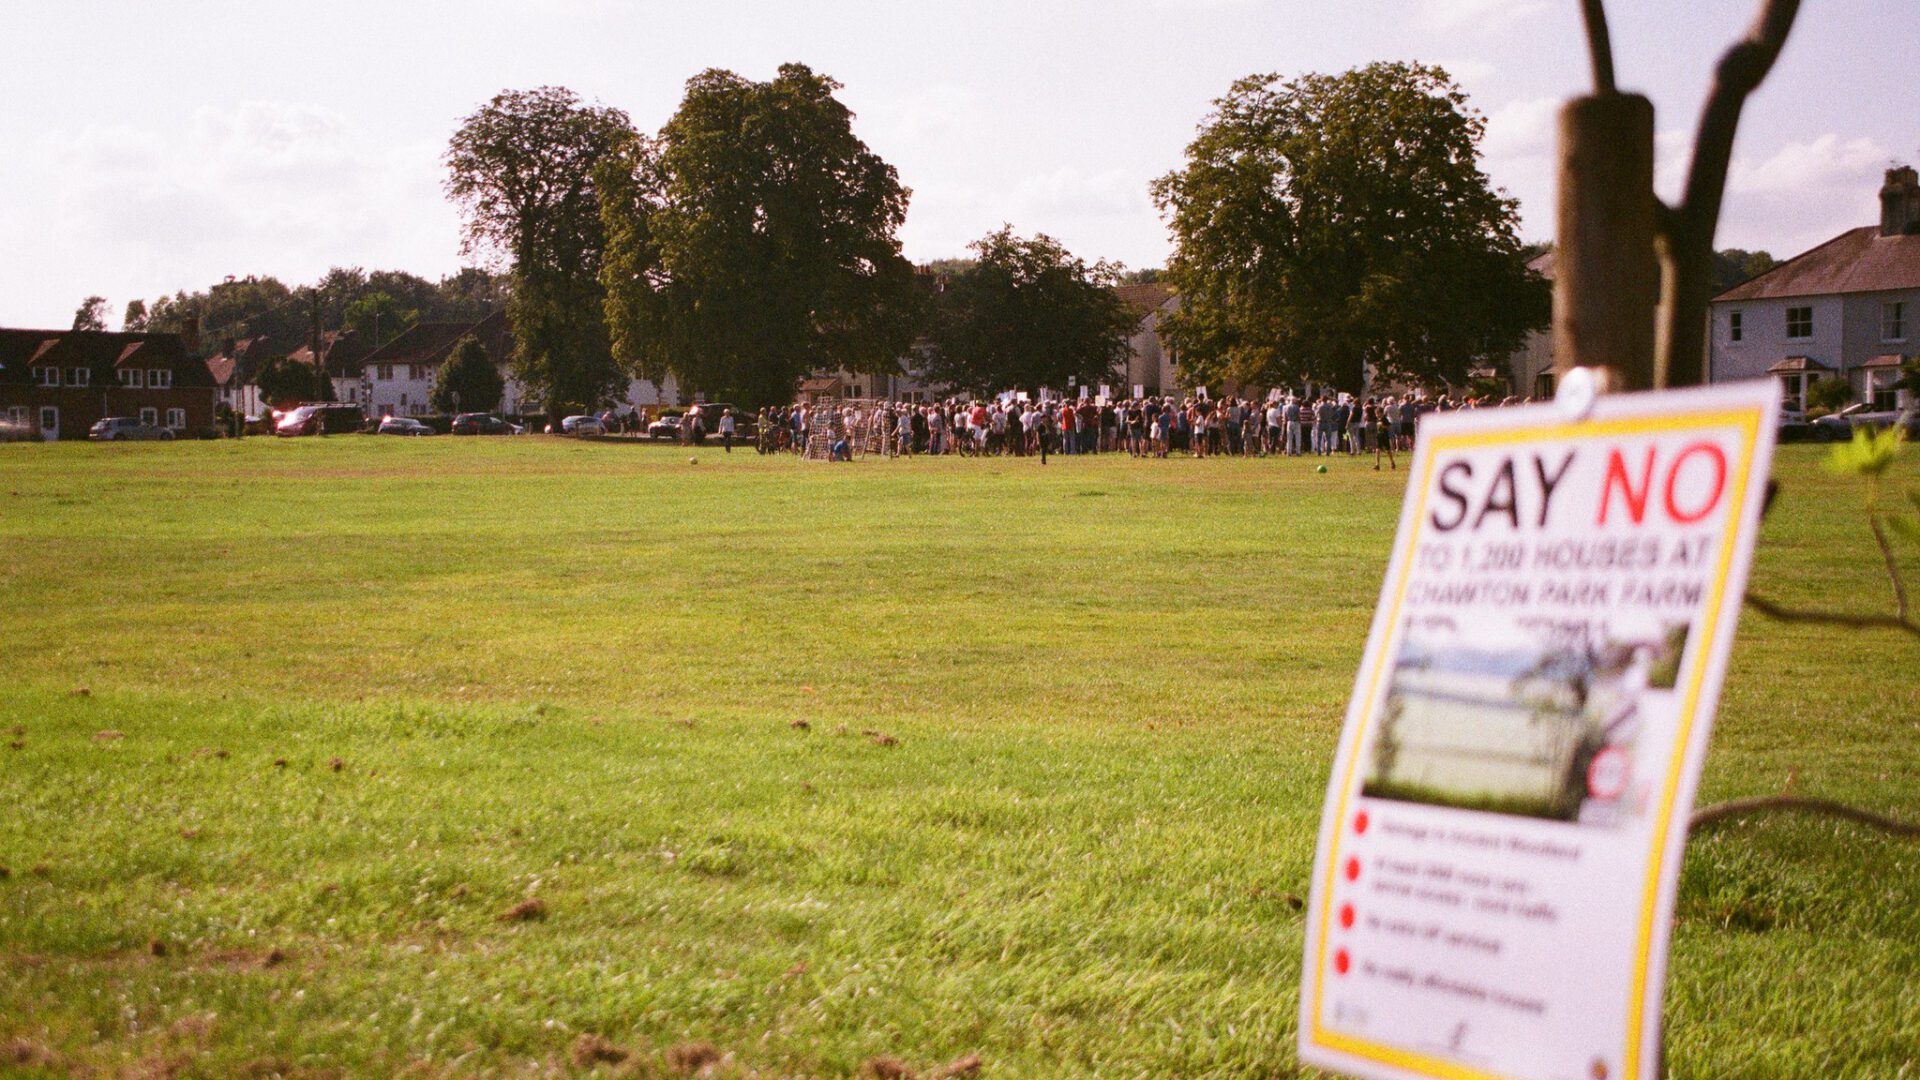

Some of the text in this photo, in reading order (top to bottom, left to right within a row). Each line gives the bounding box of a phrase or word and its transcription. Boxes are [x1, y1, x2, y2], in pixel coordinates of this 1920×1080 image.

[1430, 440, 1728, 532] SAY NO
[1420, 541, 1453, 571] TO
[1533, 537, 1661, 571] HOUSES
[1669, 535, 1714, 566] AT
[1405, 578, 1703, 606] CHAWTON PARK FARM
